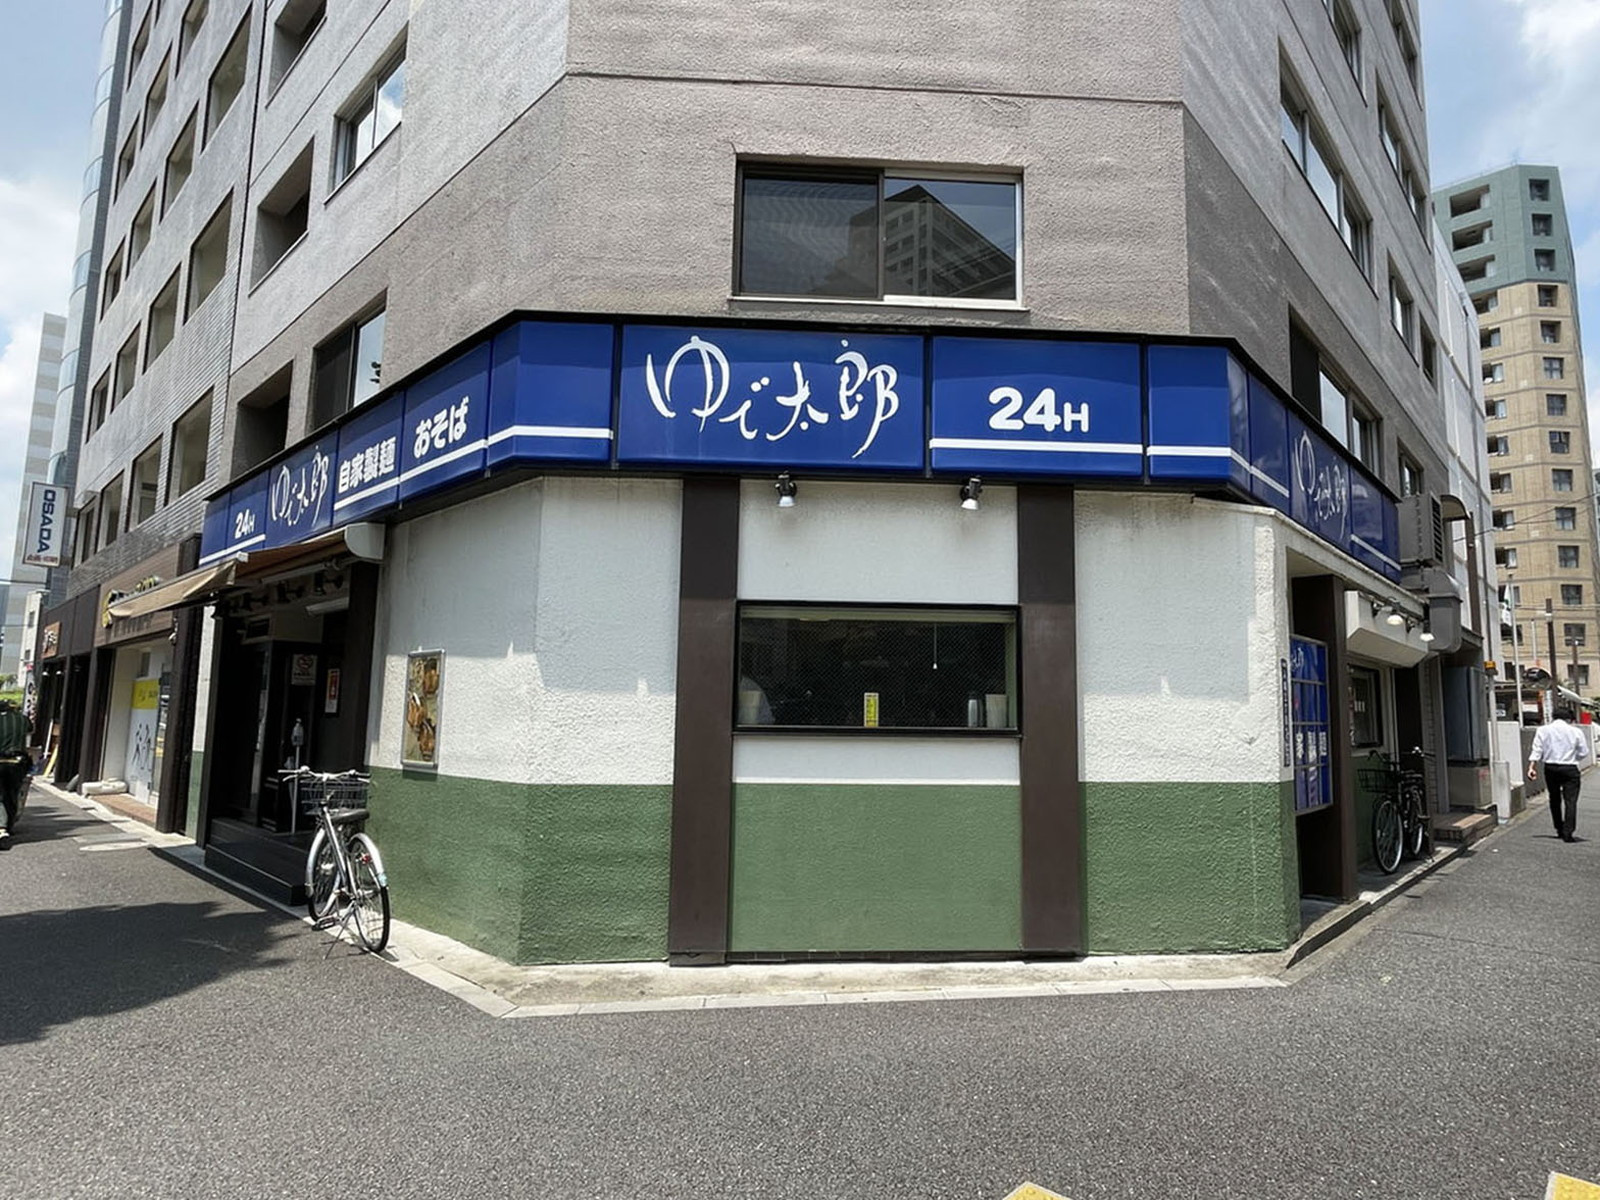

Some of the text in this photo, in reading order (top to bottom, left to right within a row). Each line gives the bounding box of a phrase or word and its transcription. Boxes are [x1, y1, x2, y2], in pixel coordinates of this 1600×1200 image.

[646, 335, 900, 459] ゆで太郎
[988, 387, 1089, 433] 24H
[413, 396, 469, 459] おそば
[337, 436, 397, 494] 自家製麺
[36, 489, 57, 553] OSADA
[234, 508, 255, 539] 24H
